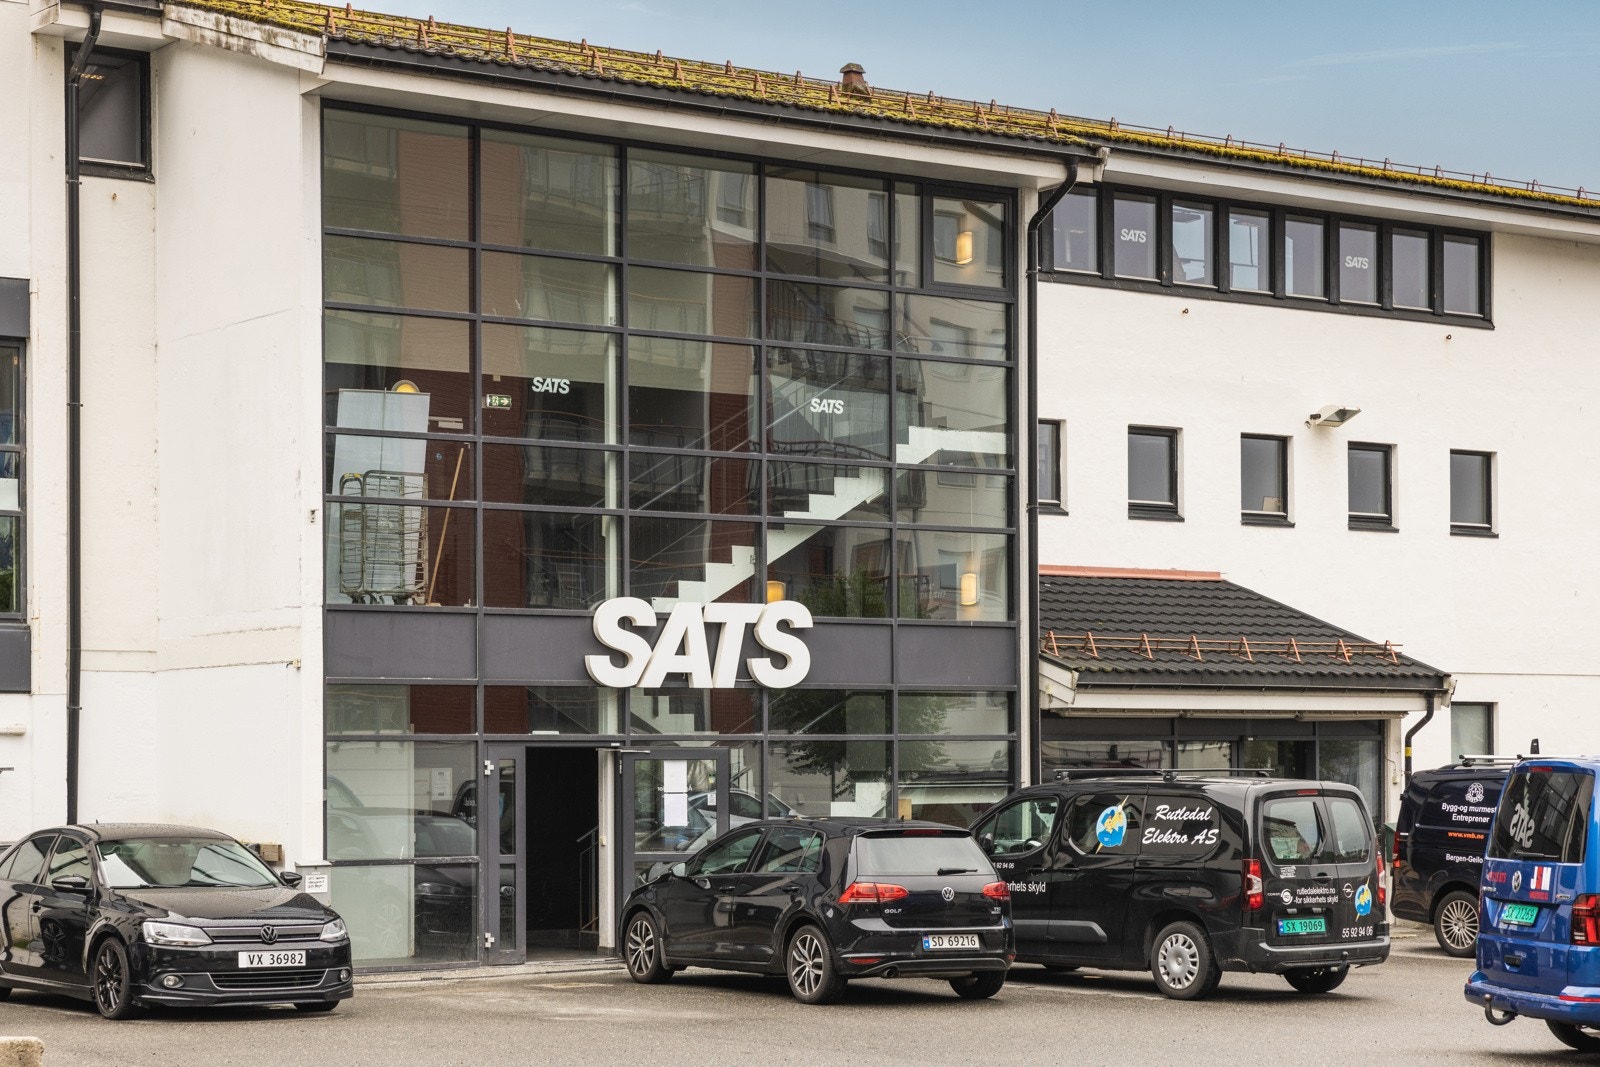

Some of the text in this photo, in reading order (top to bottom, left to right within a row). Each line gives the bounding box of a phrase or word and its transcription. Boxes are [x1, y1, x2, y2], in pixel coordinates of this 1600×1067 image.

[1120, 228, 1147, 243] SATS
[1344, 255, 1369, 269] SATS
[531, 376, 571, 394] SATS
[810, 397, 844, 415] SATS
[585, 597, 814, 689] SATS
[1154, 804, 1213, 821] Rutledal
[1452, 813, 1490, 823] Entreprenør
[1142, 827, 1220, 845] Elektro AS
[1447, 831, 1485, 840] www.vmb.no
[1027, 881, 1046, 895] skyld
[1296, 886, 1336, 896] rutledalelektro.no
[1303, 896, 1327, 904] sikkerhets
[1326, 895, 1339, 905] skyld
[1286, 921, 1323, 932] SX 19069
[1342, 926, 1374, 938] 55 92 94 06
[931, 935, 976, 946] SD 69216
[248, 953, 304, 965] VX 36982
